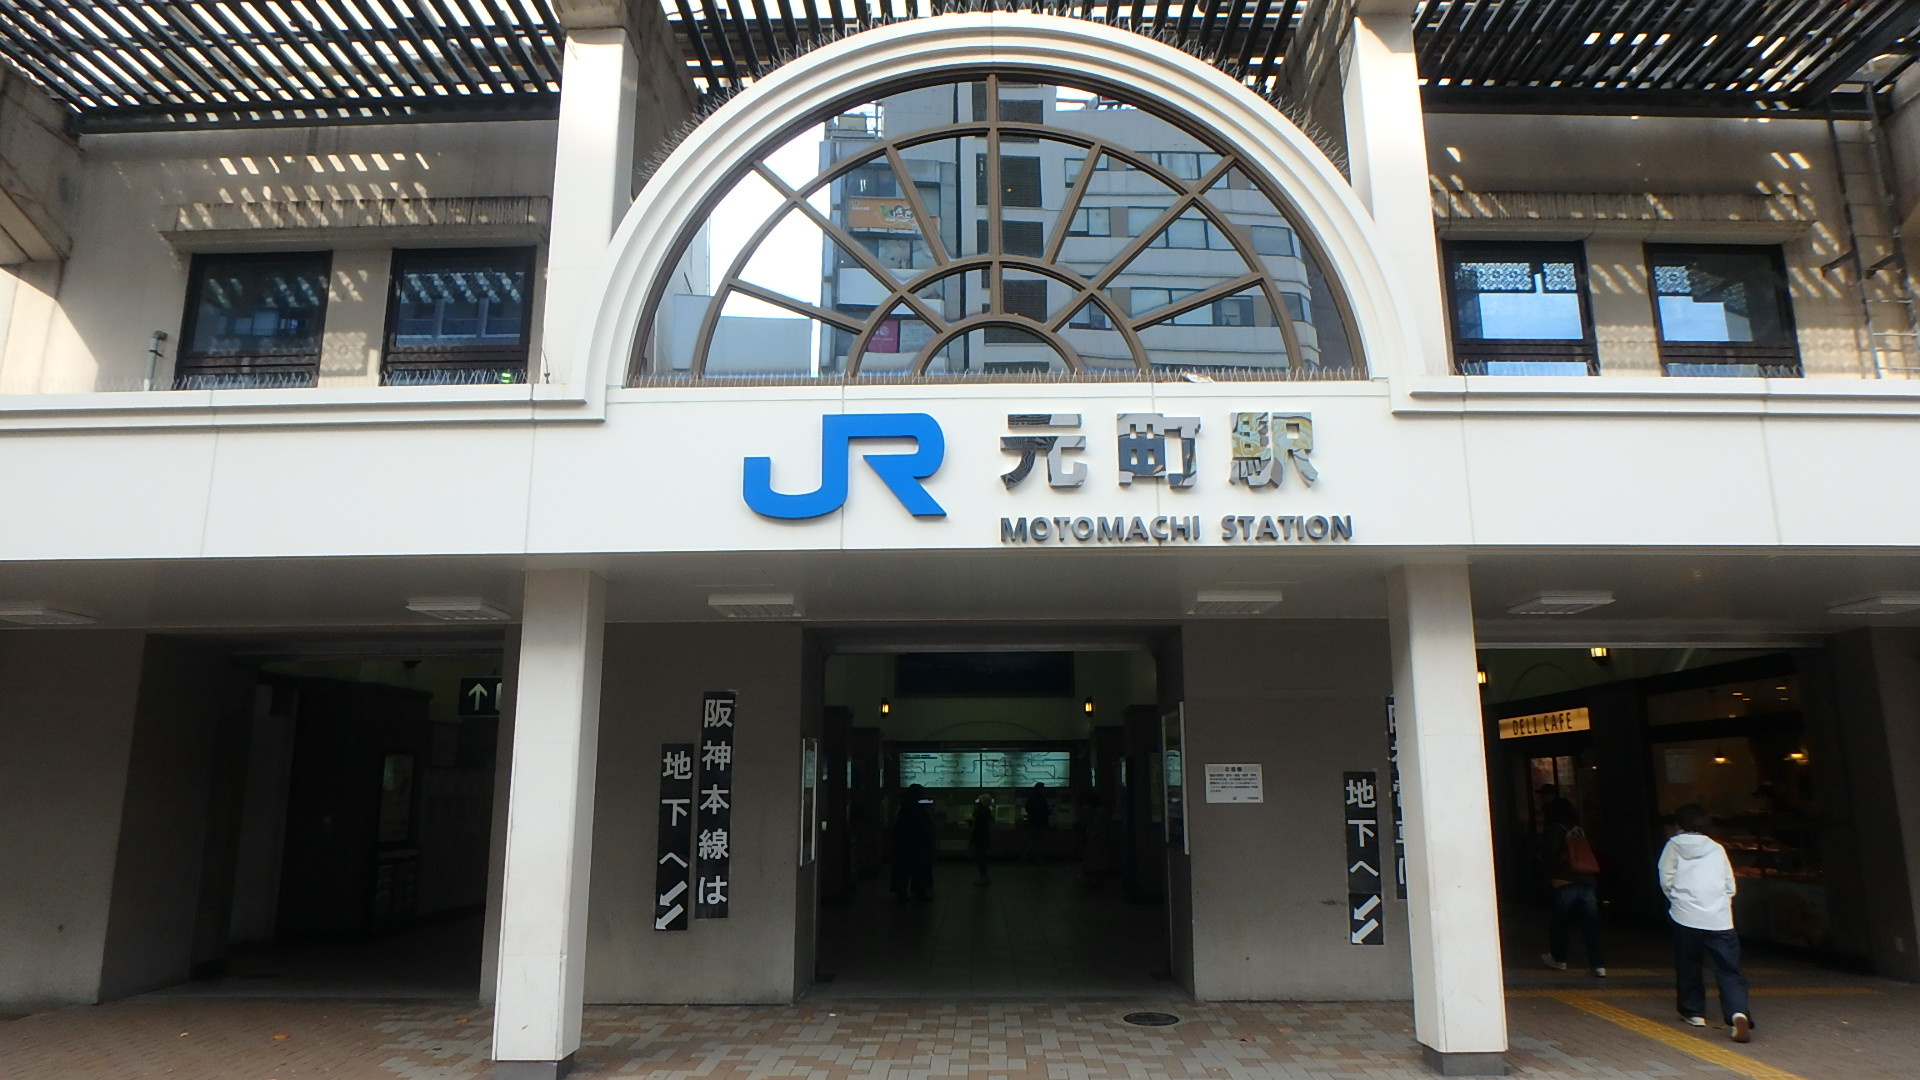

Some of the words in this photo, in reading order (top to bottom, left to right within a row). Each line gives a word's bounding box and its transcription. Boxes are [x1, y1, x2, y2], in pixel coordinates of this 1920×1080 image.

[743, 413, 947, 520] JR
[1000, 412, 1320, 491] 元町駅
[1001, 516, 1201, 544] MOTOMACHI
[1222, 515, 1354, 544] STATION
[1512, 717, 1537, 735] DELI
[1543, 712, 1572, 731] CAFE
[659, 751, 692, 868] 地下へ
[698, 699, 733, 905] 阪神本線は
[1346, 778, 1379, 877] 地下へ
